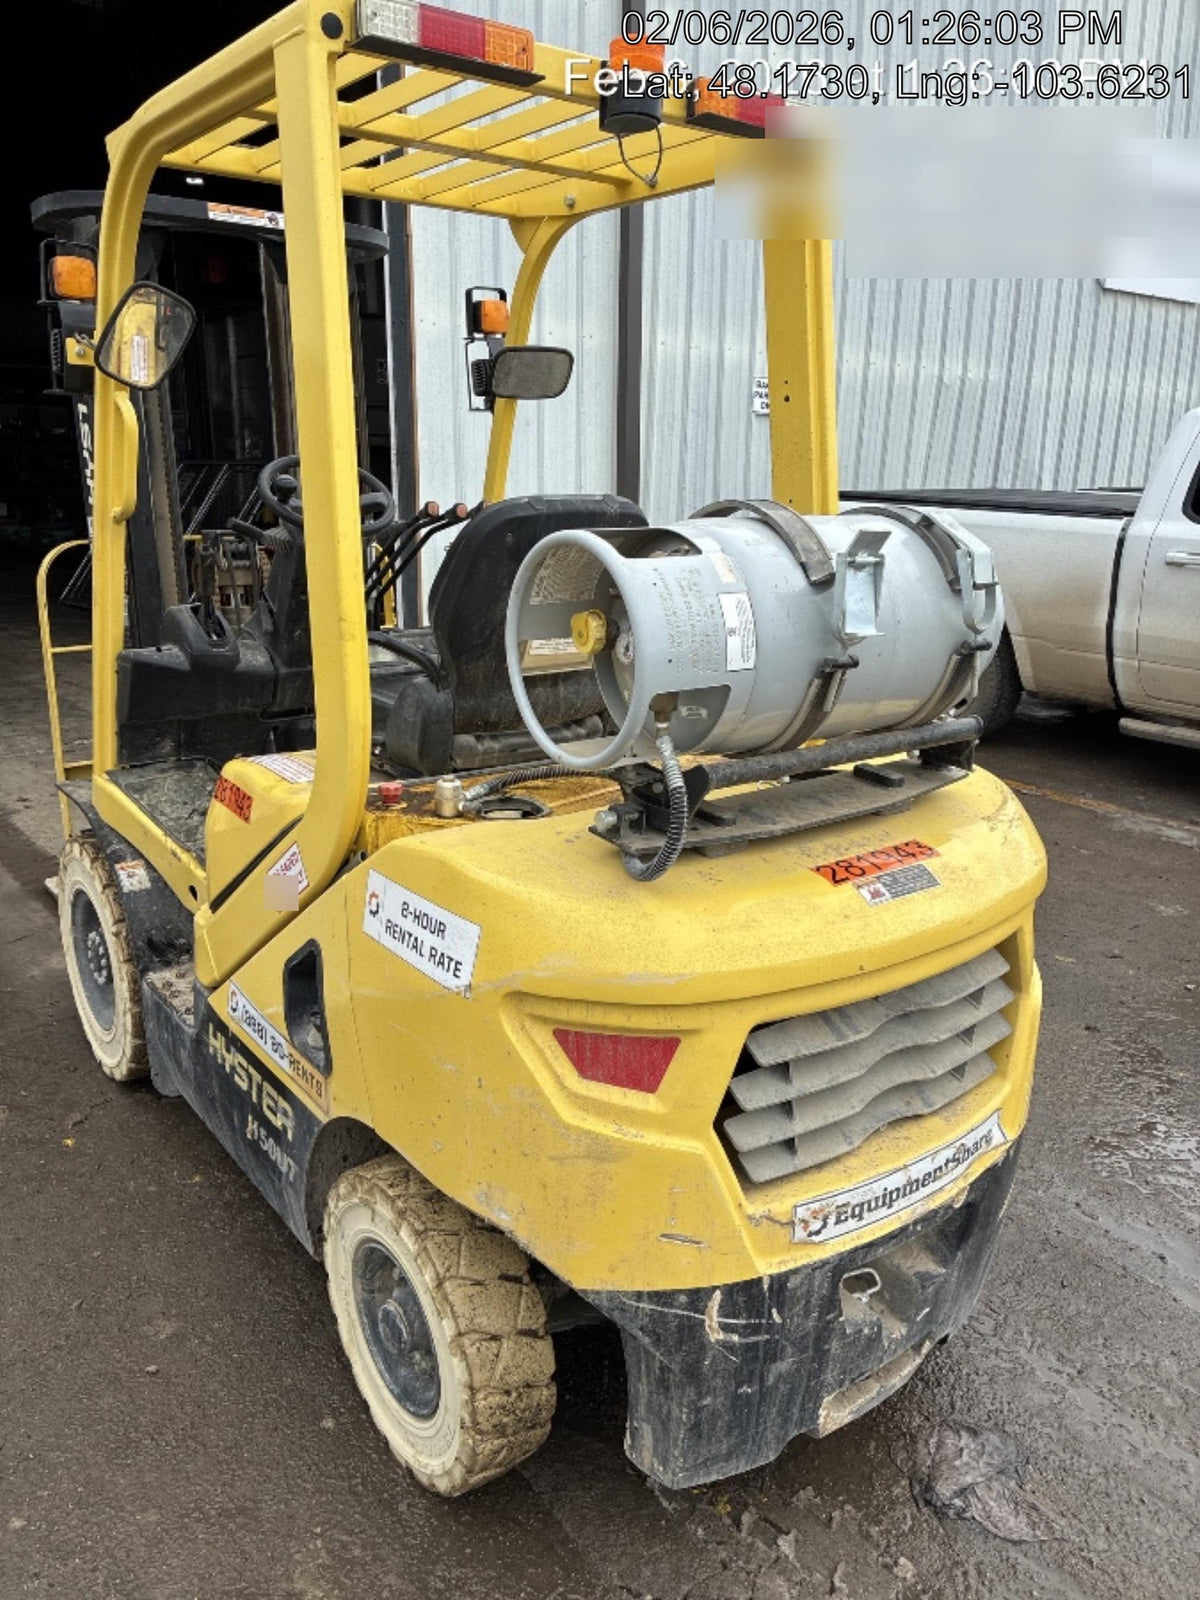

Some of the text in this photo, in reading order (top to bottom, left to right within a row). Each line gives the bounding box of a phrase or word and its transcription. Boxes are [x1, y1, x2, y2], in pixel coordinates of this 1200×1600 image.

[815, 841, 934, 884] 281943
[385, 918, 462, 979] RENTAL RATE
[401, 901, 447, 940] 8-HOUR
[208, 1022, 296, 1142] HYSTER
[834, 1128, 994, 1227] EquipmentShare
